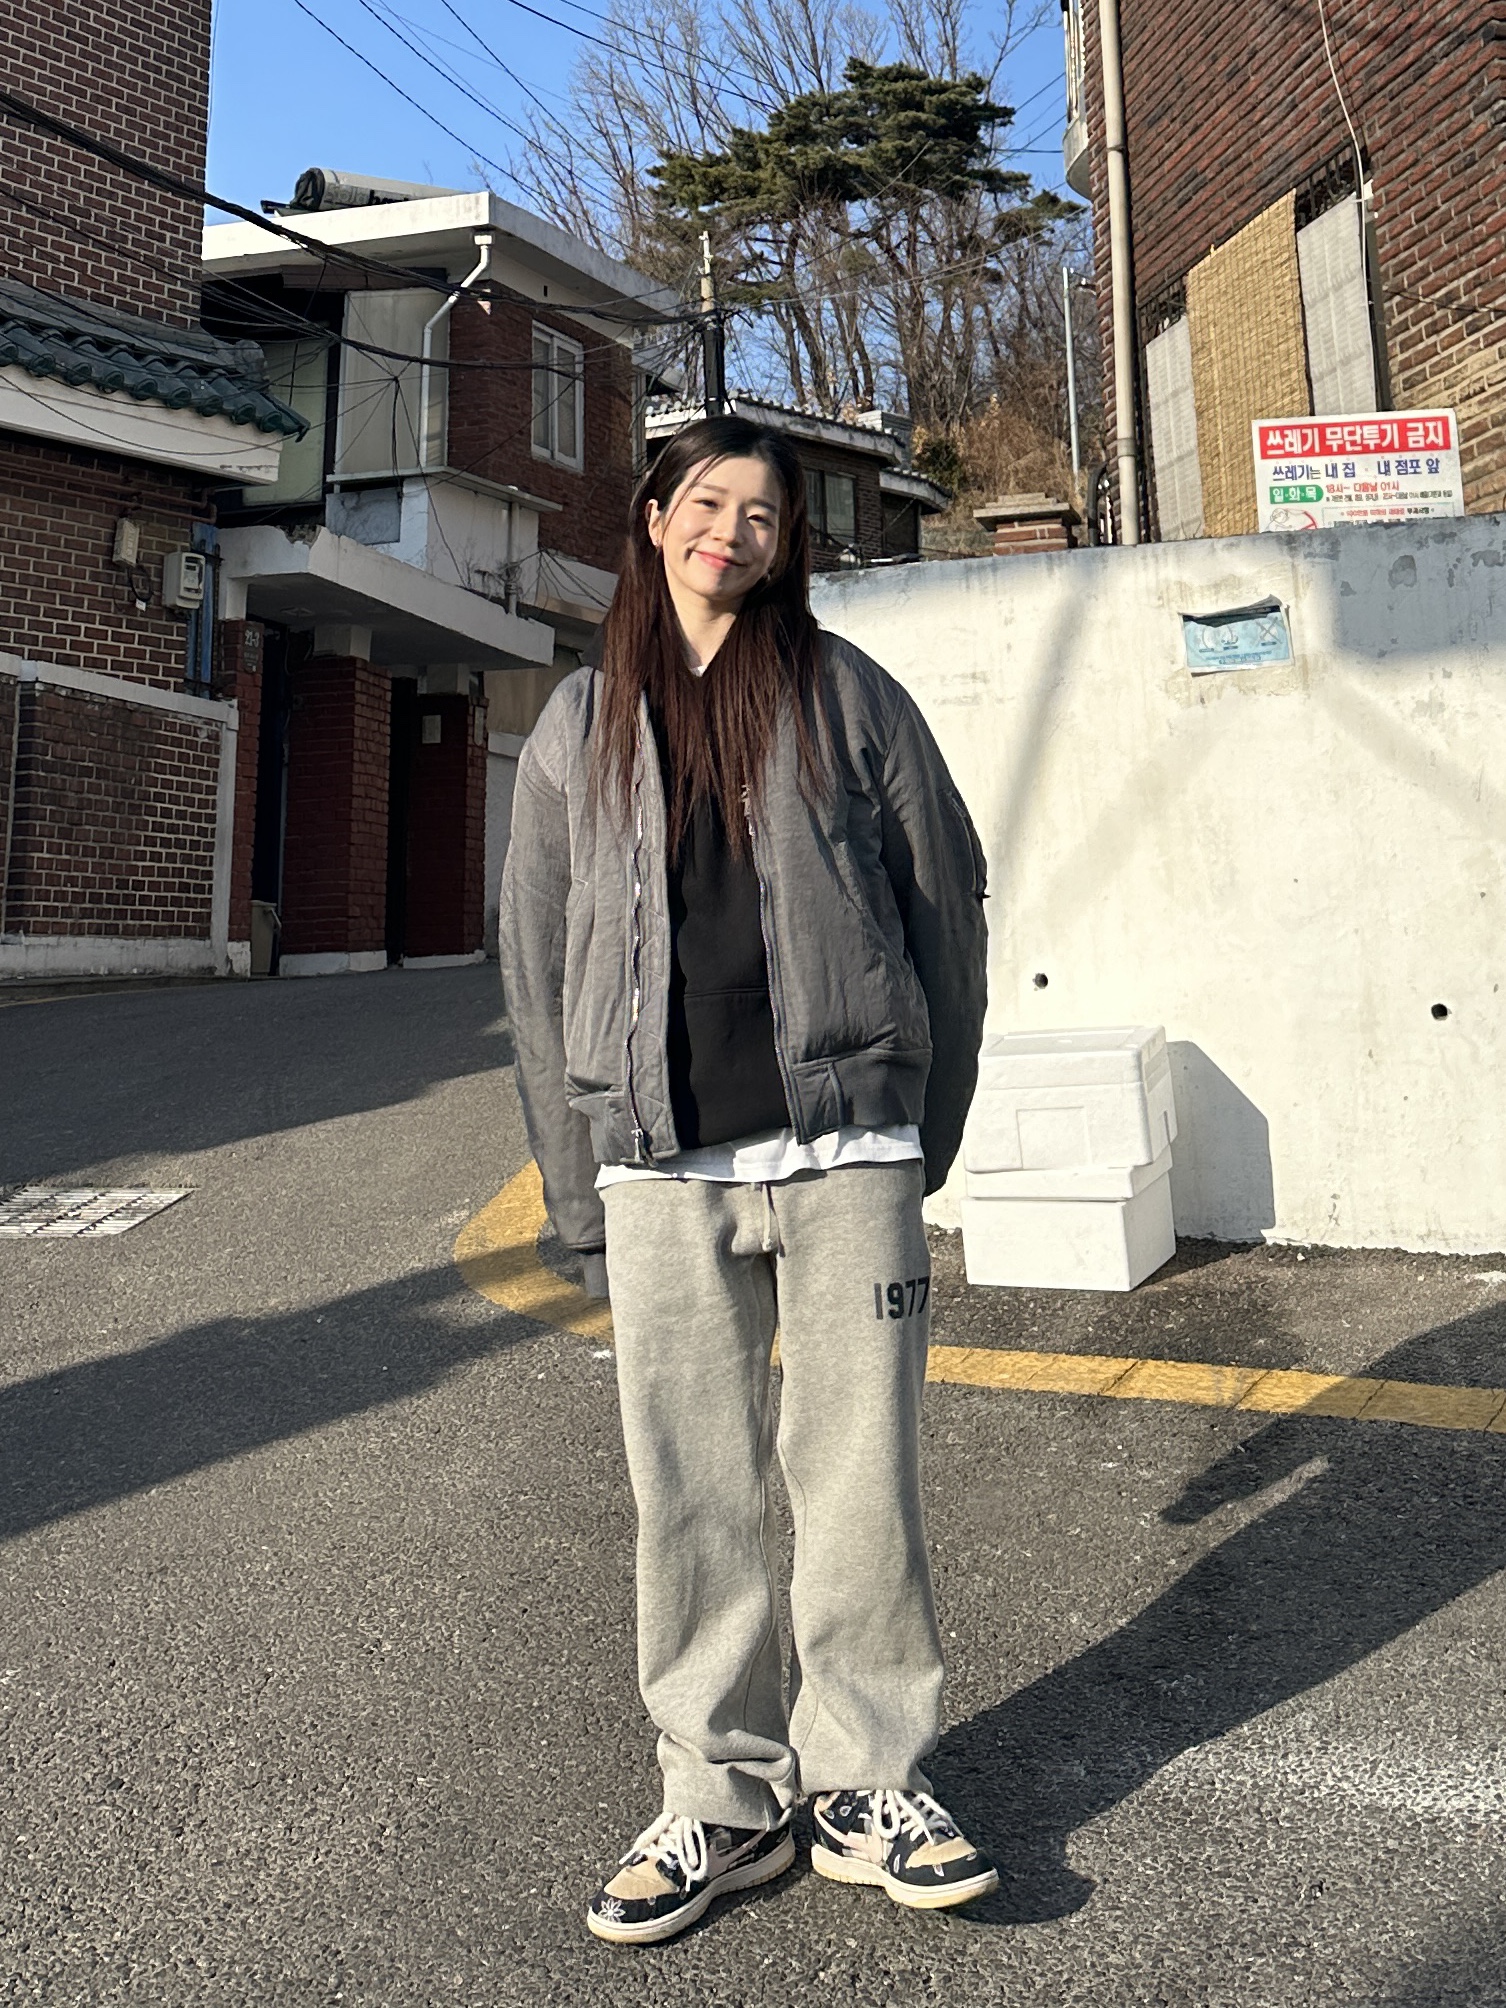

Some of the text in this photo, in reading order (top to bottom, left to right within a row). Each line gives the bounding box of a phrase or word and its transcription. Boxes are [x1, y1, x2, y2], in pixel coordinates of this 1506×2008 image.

[1266, 420, 1444, 455] 쓰레기 무단투기 금지
[1272, 457, 1440, 481] 쓰레기는 내 집 내 점포 앞
[1380, 480, 1400, 492] 01시
[873, 1276, 930, 1320] 1977
